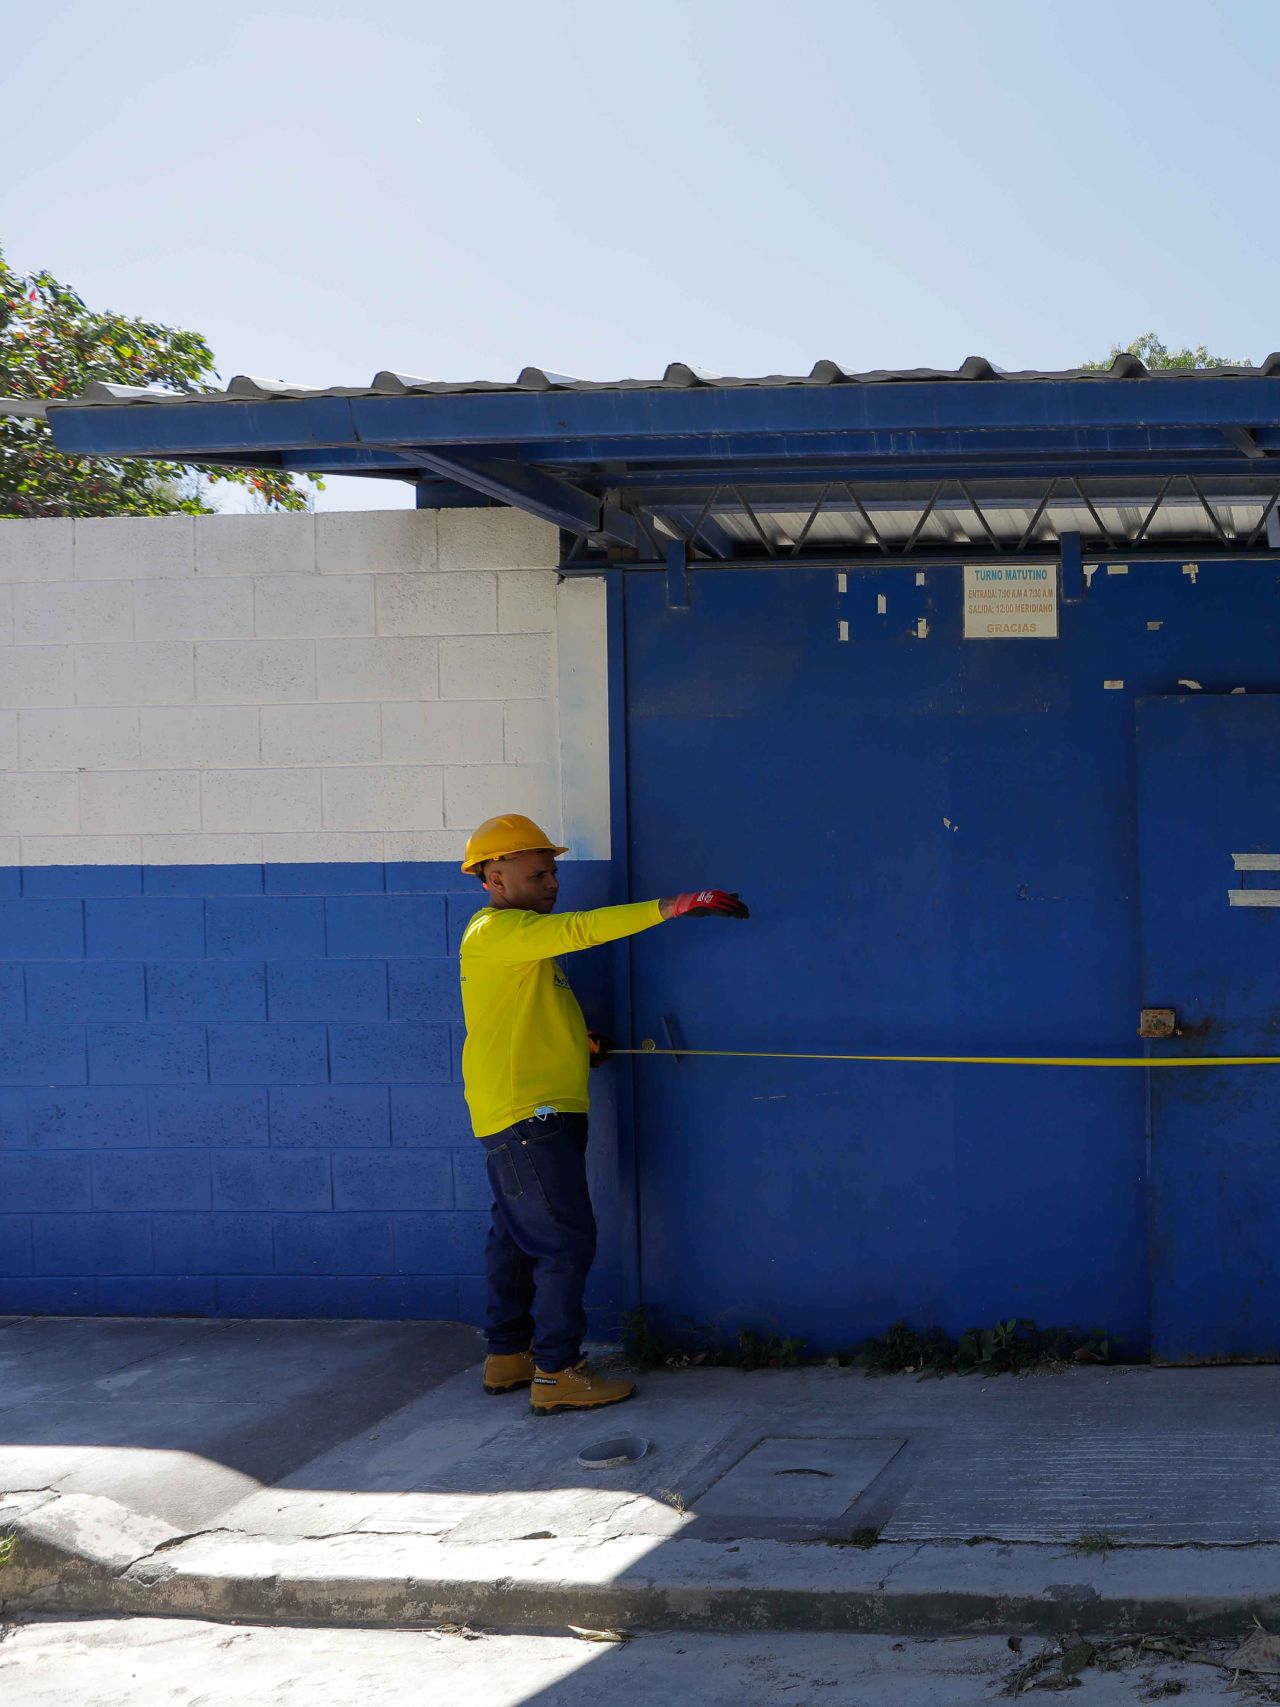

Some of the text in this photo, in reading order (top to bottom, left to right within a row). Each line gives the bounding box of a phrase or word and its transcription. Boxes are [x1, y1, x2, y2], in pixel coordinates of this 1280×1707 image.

[975, 569, 1047, 581] TURNO MATUTINO
[968, 589, 997, 599] ENTRADA:
[968, 604, 1053, 614] SALIDA: 12:00 MERIDIANO
[986, 623, 1037, 633] GRACIAS
